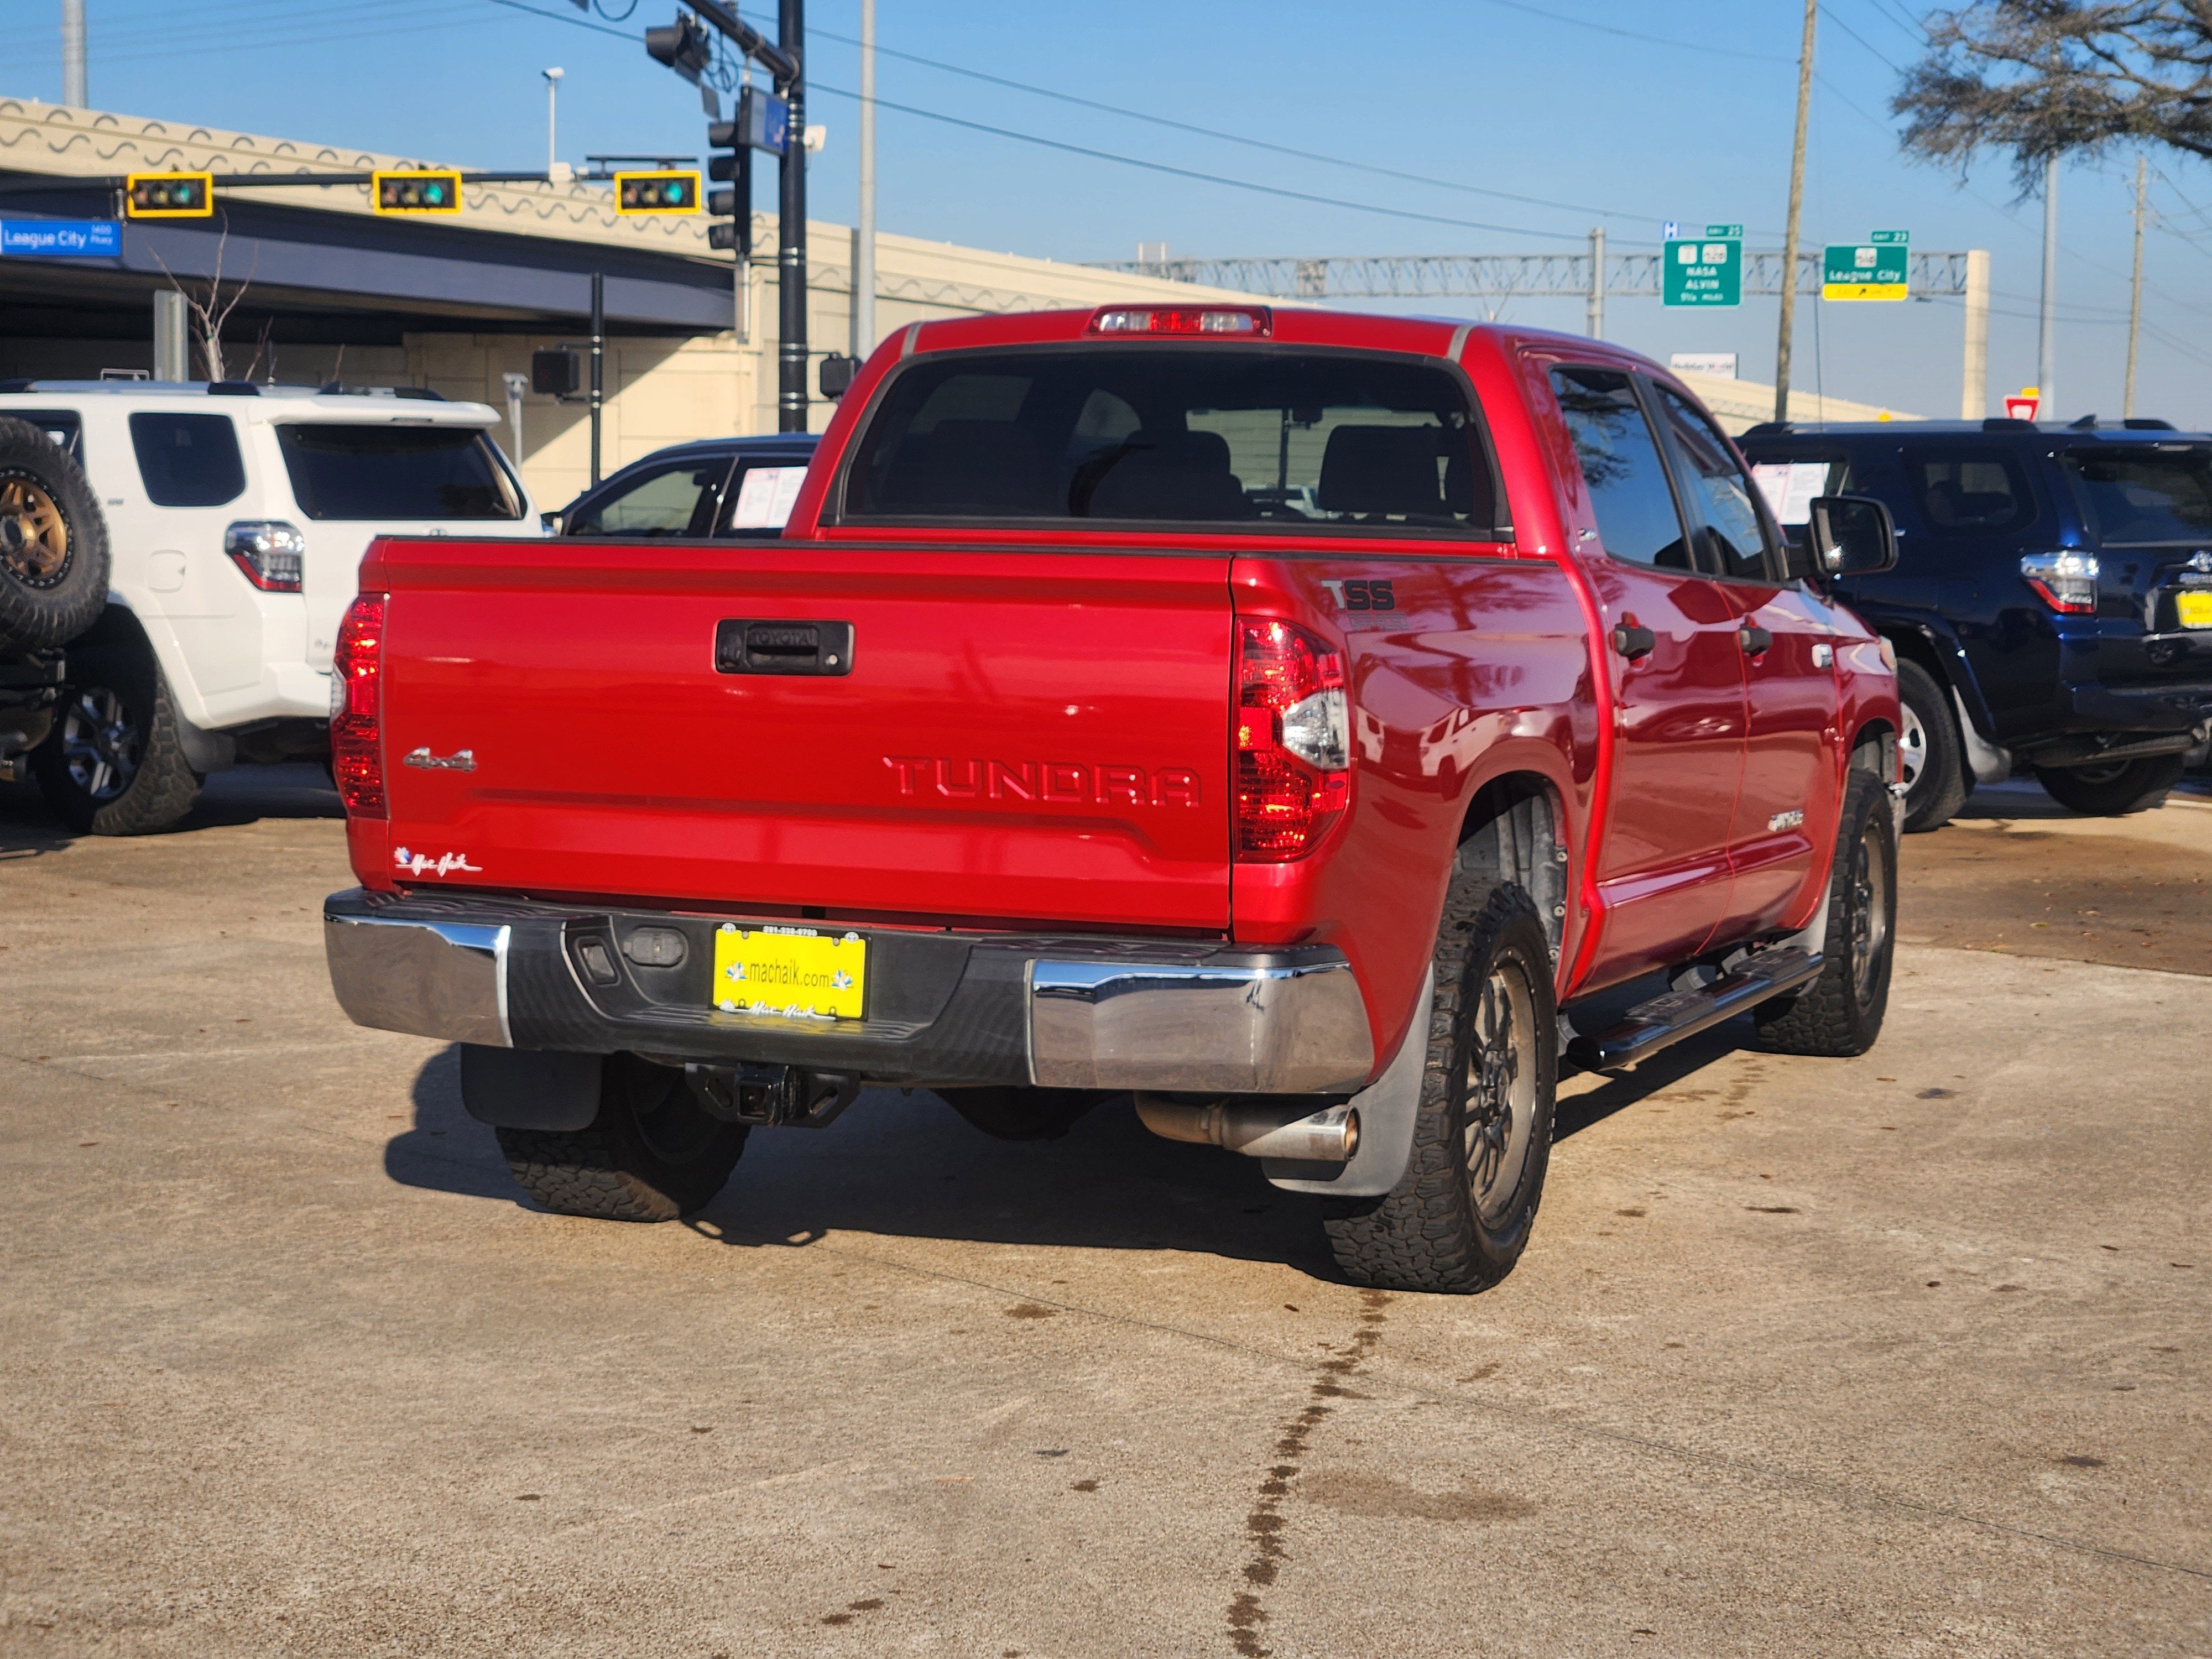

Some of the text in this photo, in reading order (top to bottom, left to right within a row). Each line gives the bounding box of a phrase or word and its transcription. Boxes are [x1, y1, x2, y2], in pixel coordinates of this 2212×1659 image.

[4, 229, 86, 250] League City
[1686, 266, 1717, 276] NASA
[1829, 269, 1901, 283] League City
[1319, 579, 1395, 611] TSS
[883, 755, 1202, 808] TUNDRA
[749, 958, 830, 988] machaik.com
